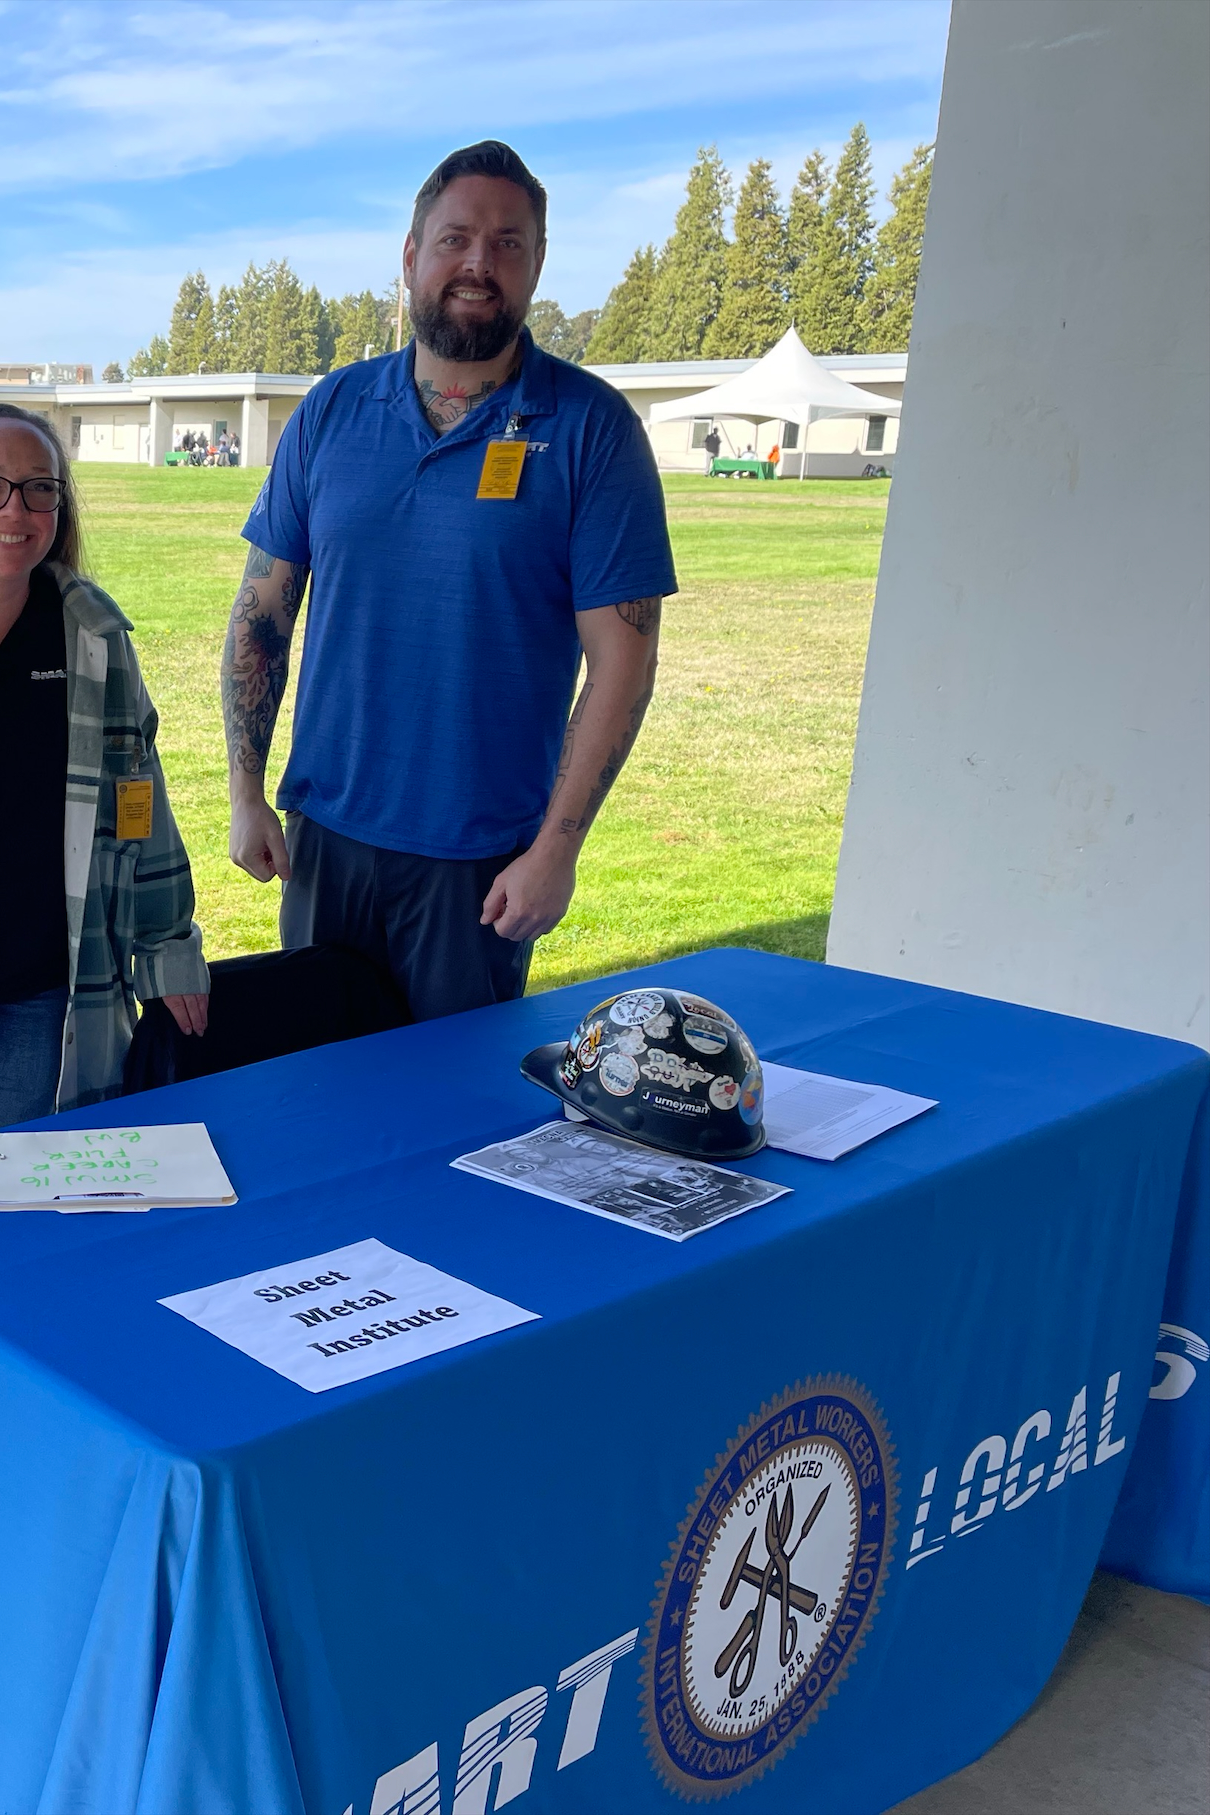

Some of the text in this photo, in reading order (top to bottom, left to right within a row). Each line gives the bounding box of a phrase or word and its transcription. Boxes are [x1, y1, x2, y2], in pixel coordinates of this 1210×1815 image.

[30, 1159, 158, 1171] CAREER
[254, 1270, 351, 1303] Sheet
[290, 1289, 397, 1328] Metal
[306, 1306, 460, 1358] Institute
[678, 1470, 734, 1583] SHEET
[738, 1410, 808, 1477] METAL
[744, 1460, 823, 1517] ORGANIZED
[906, 1370, 1126, 1570] LOCAL
[659, 1542, 879, 1772] INTERNATIONAL ASSOCIATION
[716, 1698, 742, 1719] JAN.
[773, 1650, 804, 1697] 1888
